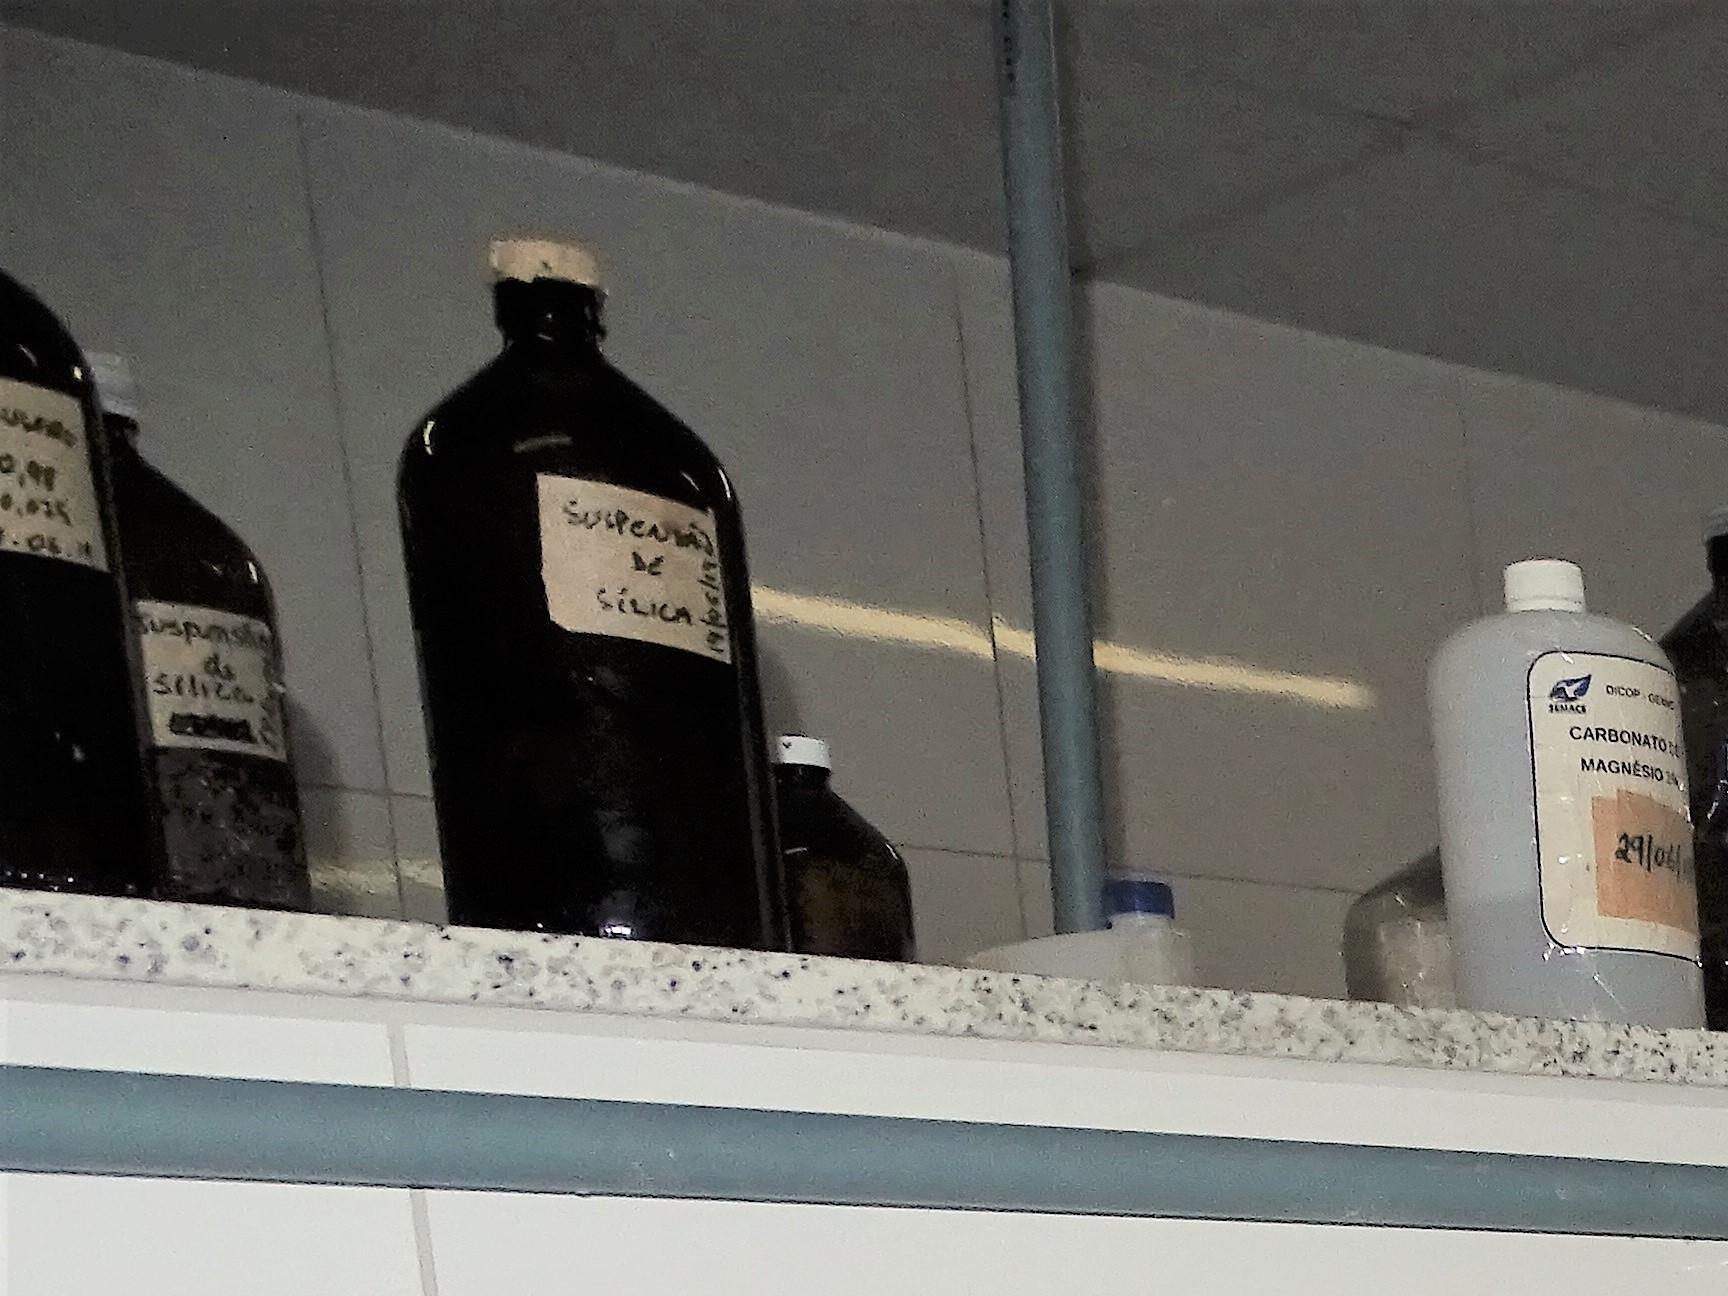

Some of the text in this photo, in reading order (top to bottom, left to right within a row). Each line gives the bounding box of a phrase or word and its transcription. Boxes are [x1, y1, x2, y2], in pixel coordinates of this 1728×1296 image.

[1548, 703, 1587, 715] SEMACE
[1569, 726, 1667, 753] CARBONATO
[1581, 757, 1664, 782] MAGNÉSIO
